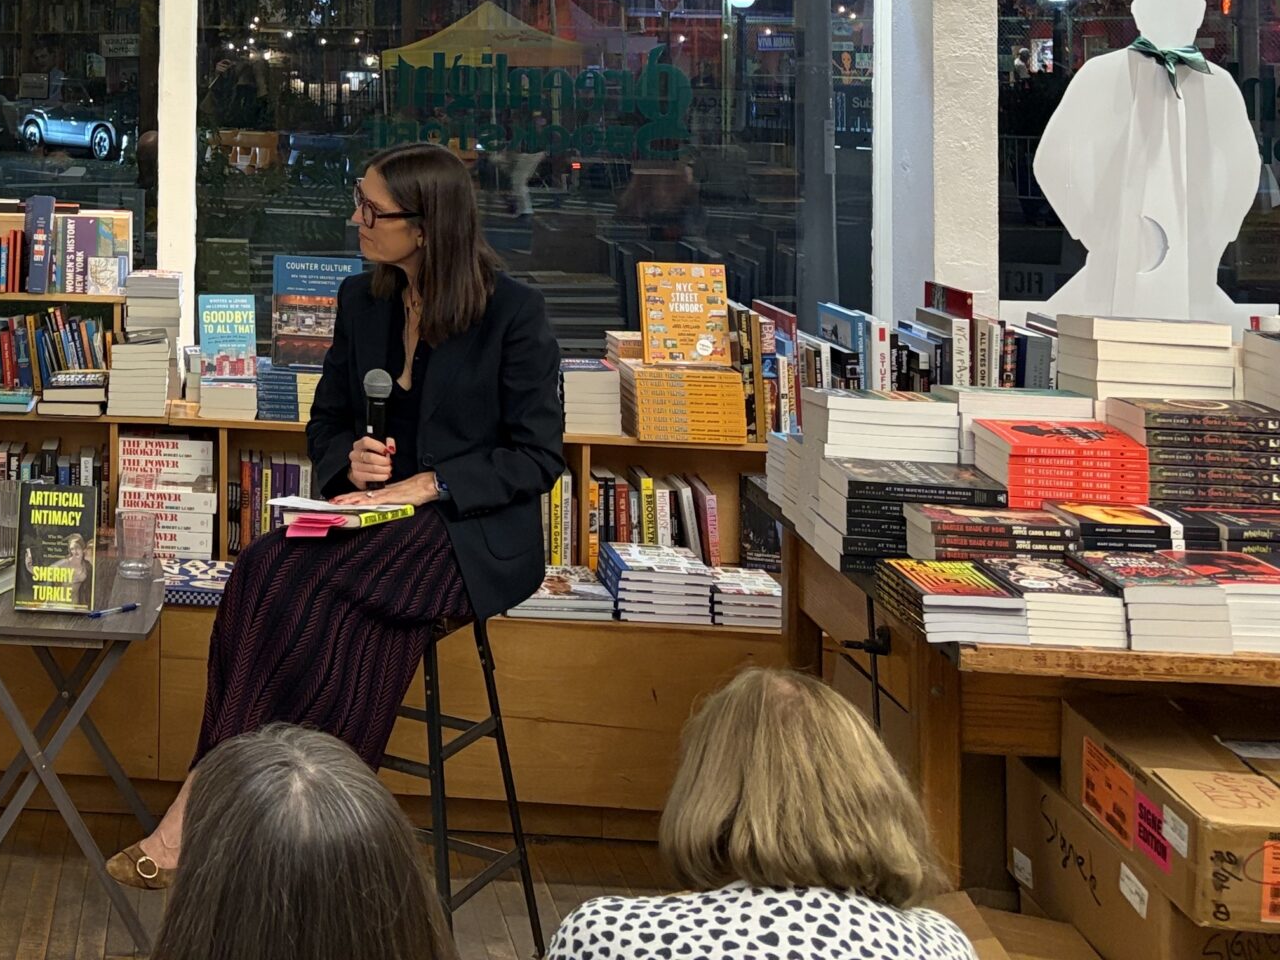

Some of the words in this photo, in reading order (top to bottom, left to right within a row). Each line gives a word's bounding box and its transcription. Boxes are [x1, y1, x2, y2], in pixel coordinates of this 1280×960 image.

[66, 218, 75, 253] HISTORY
[75, 250, 84, 273] YORK
[285, 262, 318, 271] COUNTER
[320, 264, 352, 273] CULTURE
[66, 254, 74, 293] WOMEN'S
[75, 274, 84, 293] NEW
[675, 282, 693, 292] NYC
[671, 292, 699, 302] STREET
[669, 302, 704, 313] VENDORS
[203, 311, 255, 323] GOODBYE
[203, 324, 214, 334] TO
[216, 324, 231, 333] ALL
[234, 324, 255, 334] THAT
[980, 370, 986, 381] ON
[122, 440, 141, 449] THE
[144, 440, 179, 449] POWER
[122, 448, 162, 457] BROKER
[122, 458, 140, 468] THE
[144, 459, 179, 469] POWER
[29, 490, 85, 508] ARTIFICIAL
[123, 492, 143, 500] THE
[145, 492, 181, 502] POWER
[123, 500, 164, 510] BROKER
[657, 491, 669, 530] HOTHOUSE
[30, 509, 82, 526] INTIMACY
[553, 503, 561, 529] Arshile
[645, 494, 655, 543] BROOKLYN
[1012, 529, 1027, 537] JOYCE
[1028, 529, 1044, 537] CAROL
[552, 531, 560, 555] Gorky
[1016, 542, 1031, 550] JOYCE
[32, 566, 75, 583] SHERRY
[32, 585, 72, 602] TURKLE
[1138, 802, 1163, 834] SIGNE
[1138, 821, 1168, 863] EDITION
